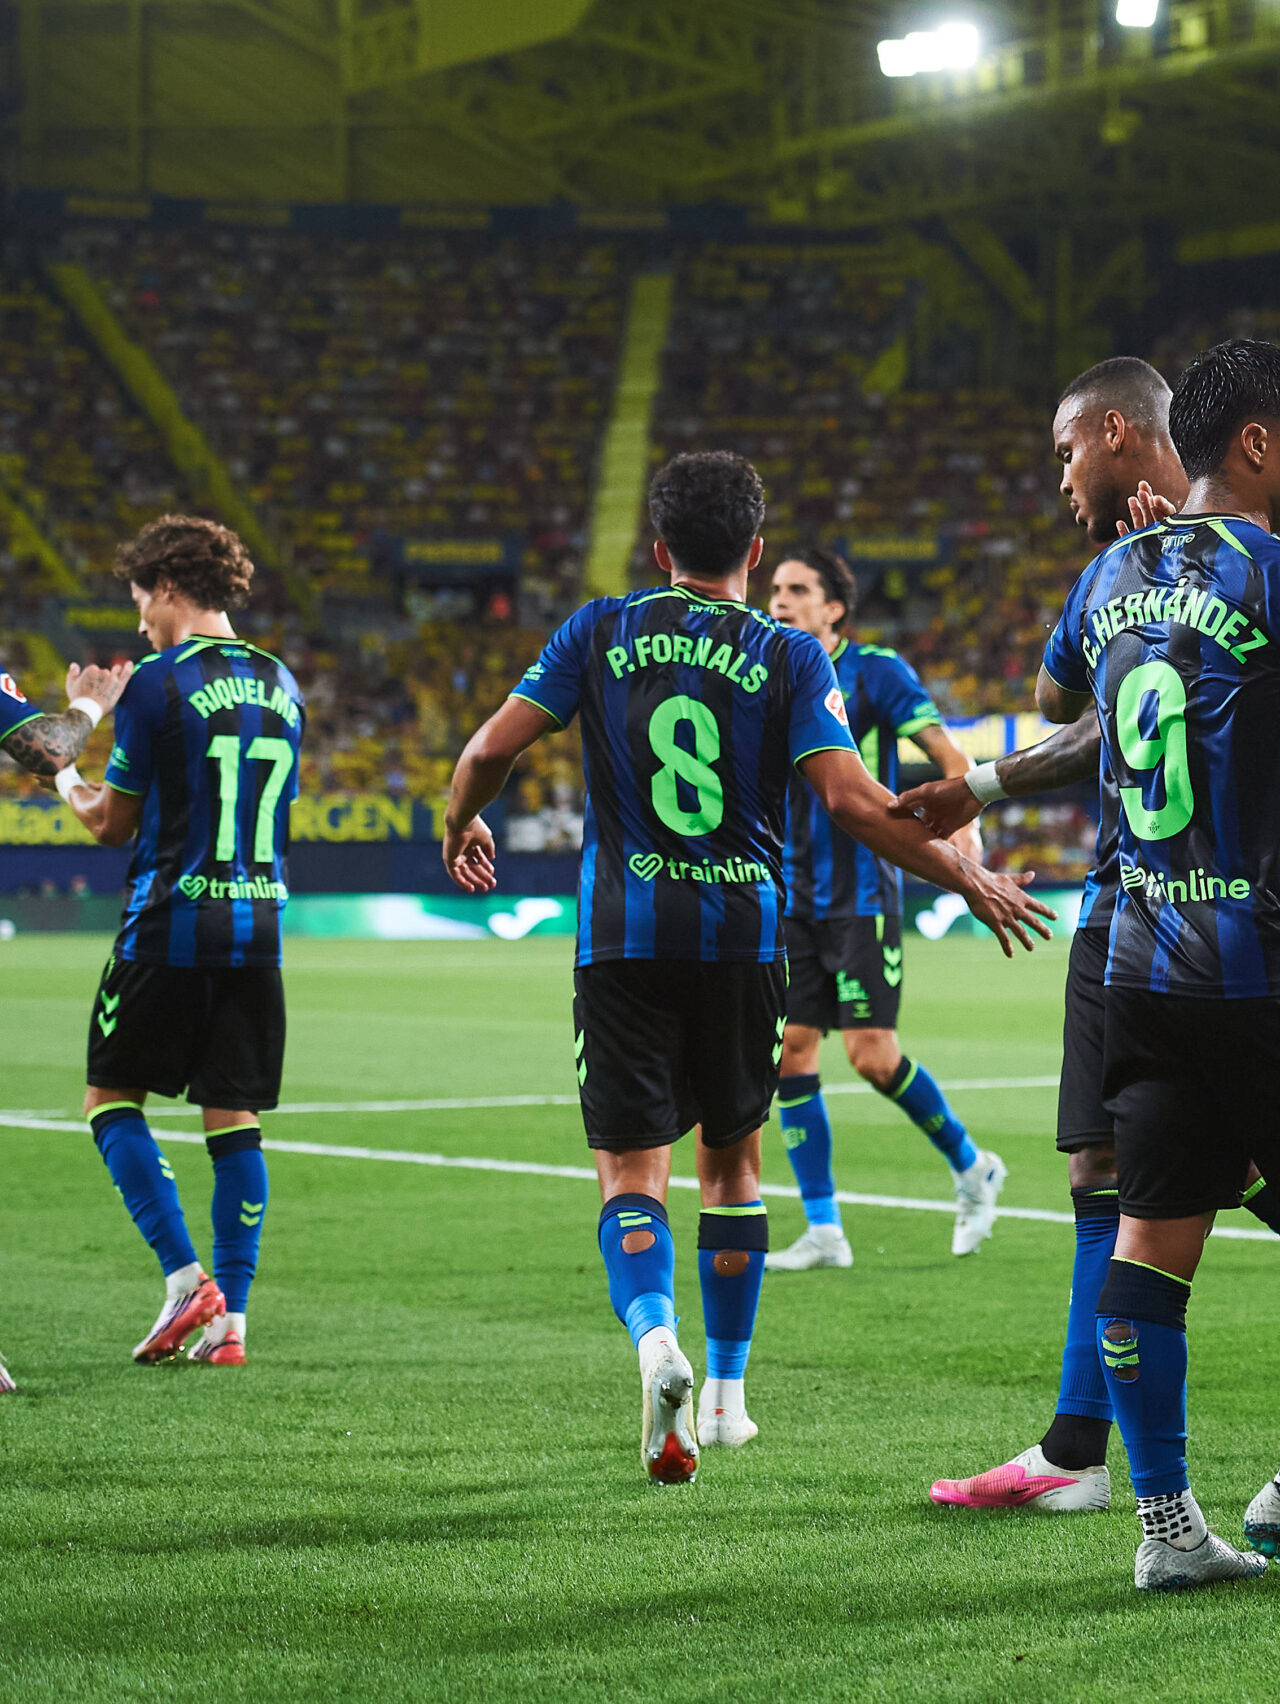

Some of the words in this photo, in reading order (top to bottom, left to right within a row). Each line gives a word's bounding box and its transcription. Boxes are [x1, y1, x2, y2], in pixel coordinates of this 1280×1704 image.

[188, 676, 300, 728] RIQUELME
[605, 633, 769, 694] P.FORNALS
[648, 694, 724, 837] 8
[1116, 661, 1194, 841] 9
[206, 734, 294, 864] 17
[1146, 868, 1251, 904] tinline
